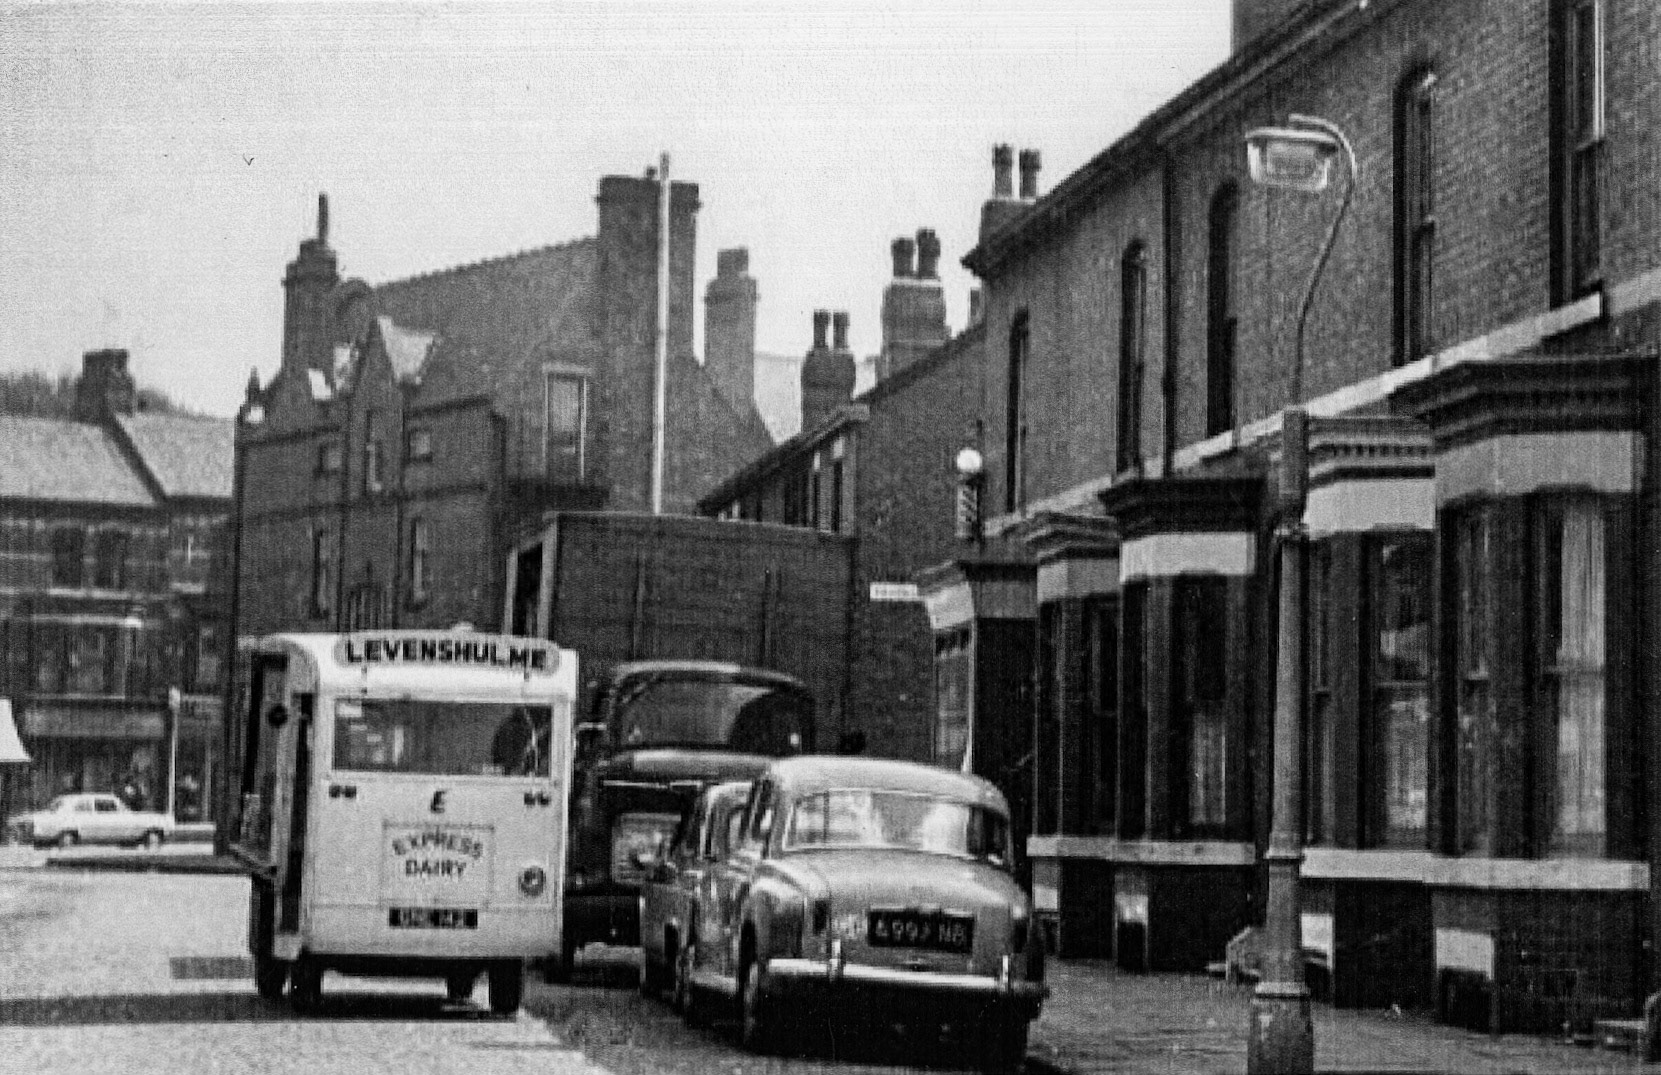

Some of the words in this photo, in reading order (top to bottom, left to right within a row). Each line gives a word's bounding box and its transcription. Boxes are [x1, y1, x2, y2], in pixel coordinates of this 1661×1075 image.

[345, 638, 547, 671] LEVENSHULME
[392, 828, 484, 860] EXPRESS
[405, 859, 467, 877] DAIRY
